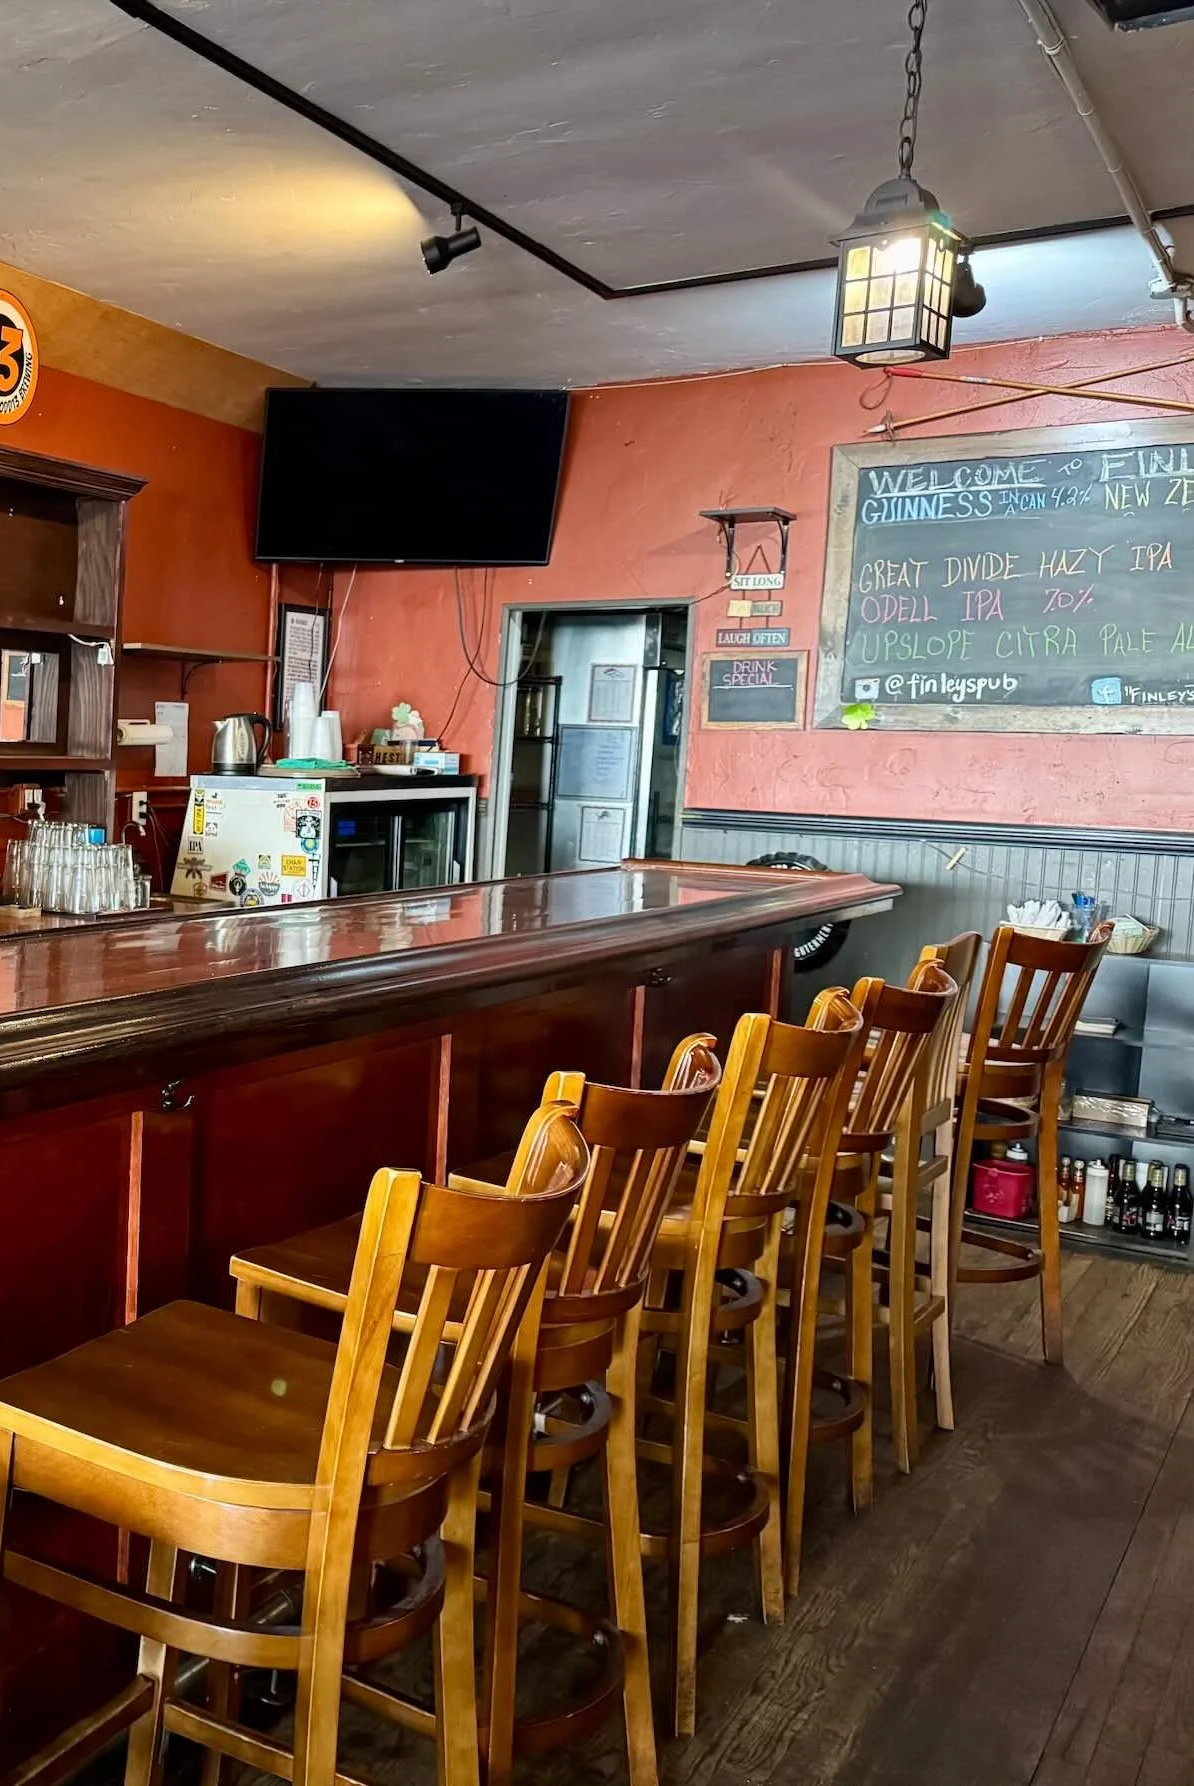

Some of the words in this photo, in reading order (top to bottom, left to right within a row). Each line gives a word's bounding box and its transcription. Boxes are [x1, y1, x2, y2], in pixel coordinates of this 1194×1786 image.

[870, 459, 1046, 494] WELCOME
[1058, 459, 1082, 475] TO
[862, 491, 992, 525] GUINNESS
[998, 490, 1019, 504] IN
[1020, 494, 1046, 510] CAN
[1105, 480, 1150, 511] NEW
[1004, 503, 1017, 516] A
[734, 577, 751, 587] SIT
[752, 576, 781, 586] LONG
[859, 558, 929, 593] GREAT
[942, 552, 1023, 587] DIVIDE
[1039, 545, 1116, 579] HAZY
[1130, 541, 1174, 573] IPA
[861, 595, 938, 624] ODELL
[961, 589, 1005, 622] IPA
[718, 632, 751, 644] LAUGH
[752, 632, 785, 645] OFTEN
[861, 630, 976, 664] UPSLOPE
[996, 625, 1078, 659] CITRA
[1099, 622, 1158, 656] PALE
[723, 673, 778, 687] SPECIAL
[733, 660, 778, 673] DRINK
[885, 672, 1018, 703] @finleyspub
